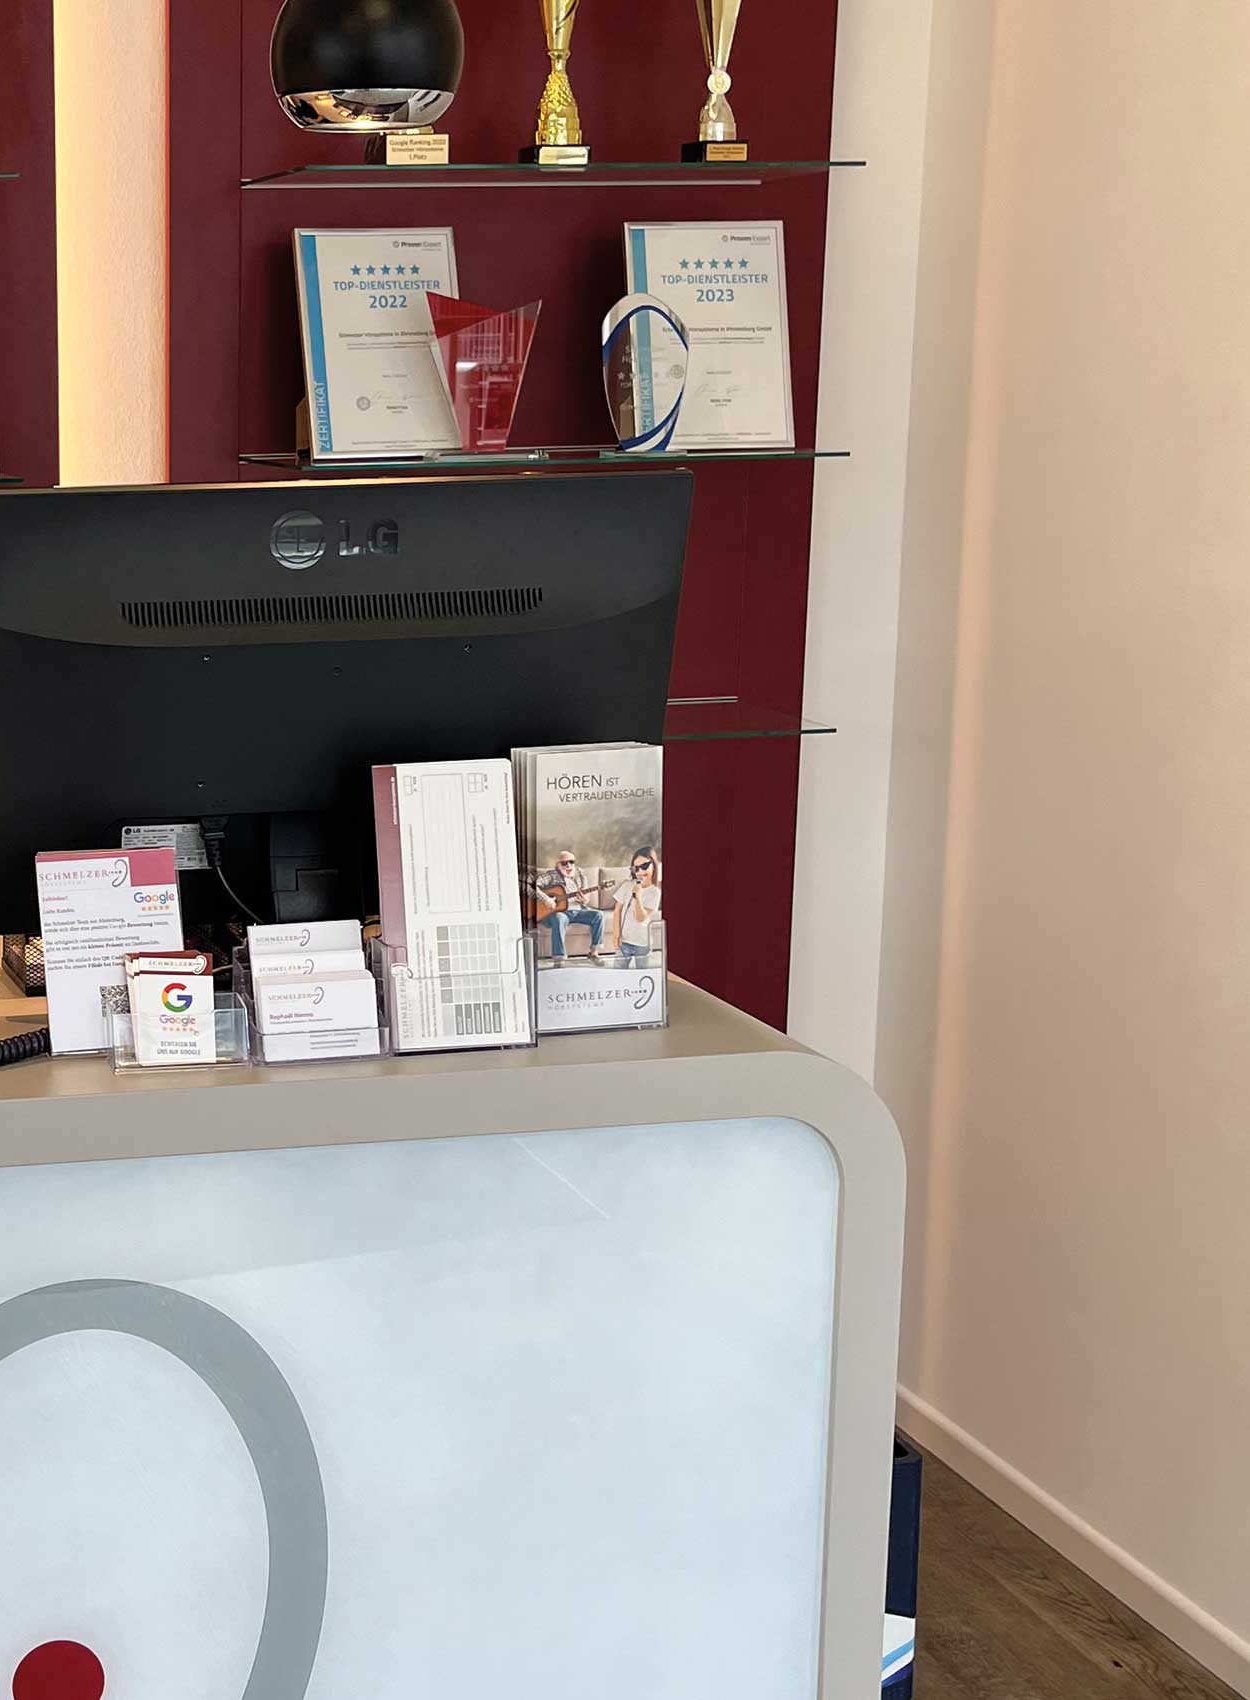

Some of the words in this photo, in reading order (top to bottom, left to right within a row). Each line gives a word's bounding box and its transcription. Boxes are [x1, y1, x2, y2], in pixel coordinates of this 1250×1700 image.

[333, 280, 441, 291] TOP-DIENSTLEISTER
[661, 274, 768, 284] TOP-DIENSTLEISTER
[368, 295, 408, 309] 2022
[696, 289, 735, 302] 2023
[314, 381, 330, 448] ZERTIFIKAT
[339, 519, 399, 556] LG
[546, 773, 602, 790] HÖREN
[606, 777, 620, 787] IST
[559, 788, 654, 803] VERTRAUENSSACHE
[39, 869, 109, 881] SCHMELZER
[133, 890, 175, 904] Google
[162, 982, 193, 1013] G
[548, 988, 632, 1004] SCHMELZER
[159, 1014, 196, 1027] Google
